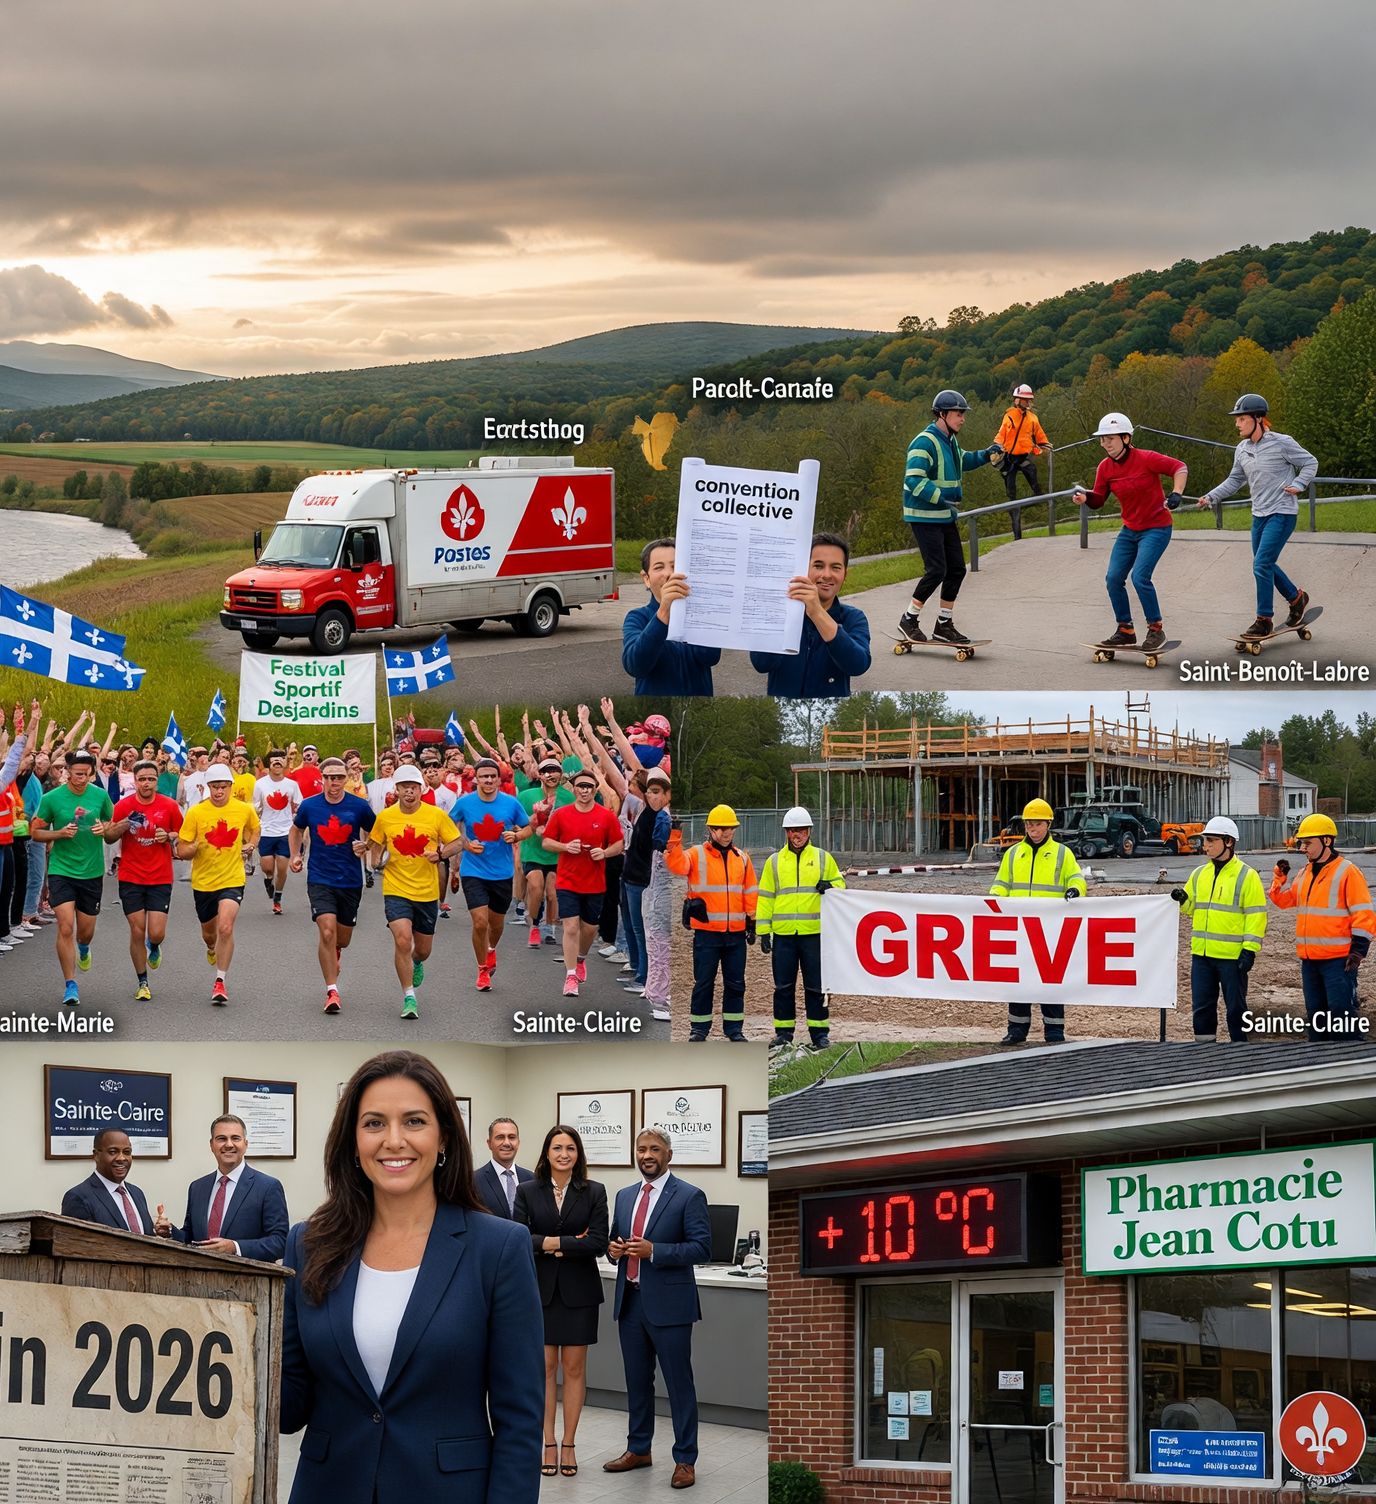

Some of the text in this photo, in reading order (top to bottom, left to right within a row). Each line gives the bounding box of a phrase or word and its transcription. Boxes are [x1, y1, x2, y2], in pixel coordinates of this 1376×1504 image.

[695, 479, 800, 501] convention
[701, 498, 793, 519] collective
[270, 659, 346, 677] Festival
[273, 680, 342, 701] Sportif
[257, 700, 359, 722] Desjardins
[855, 898, 1137, 987] GRÈVE
[1107, 1157, 1343, 1215] Pharmacie
[1114, 1211, 1338, 1260] Jean Cotu
[71, 1320, 234, 1420] 2026
